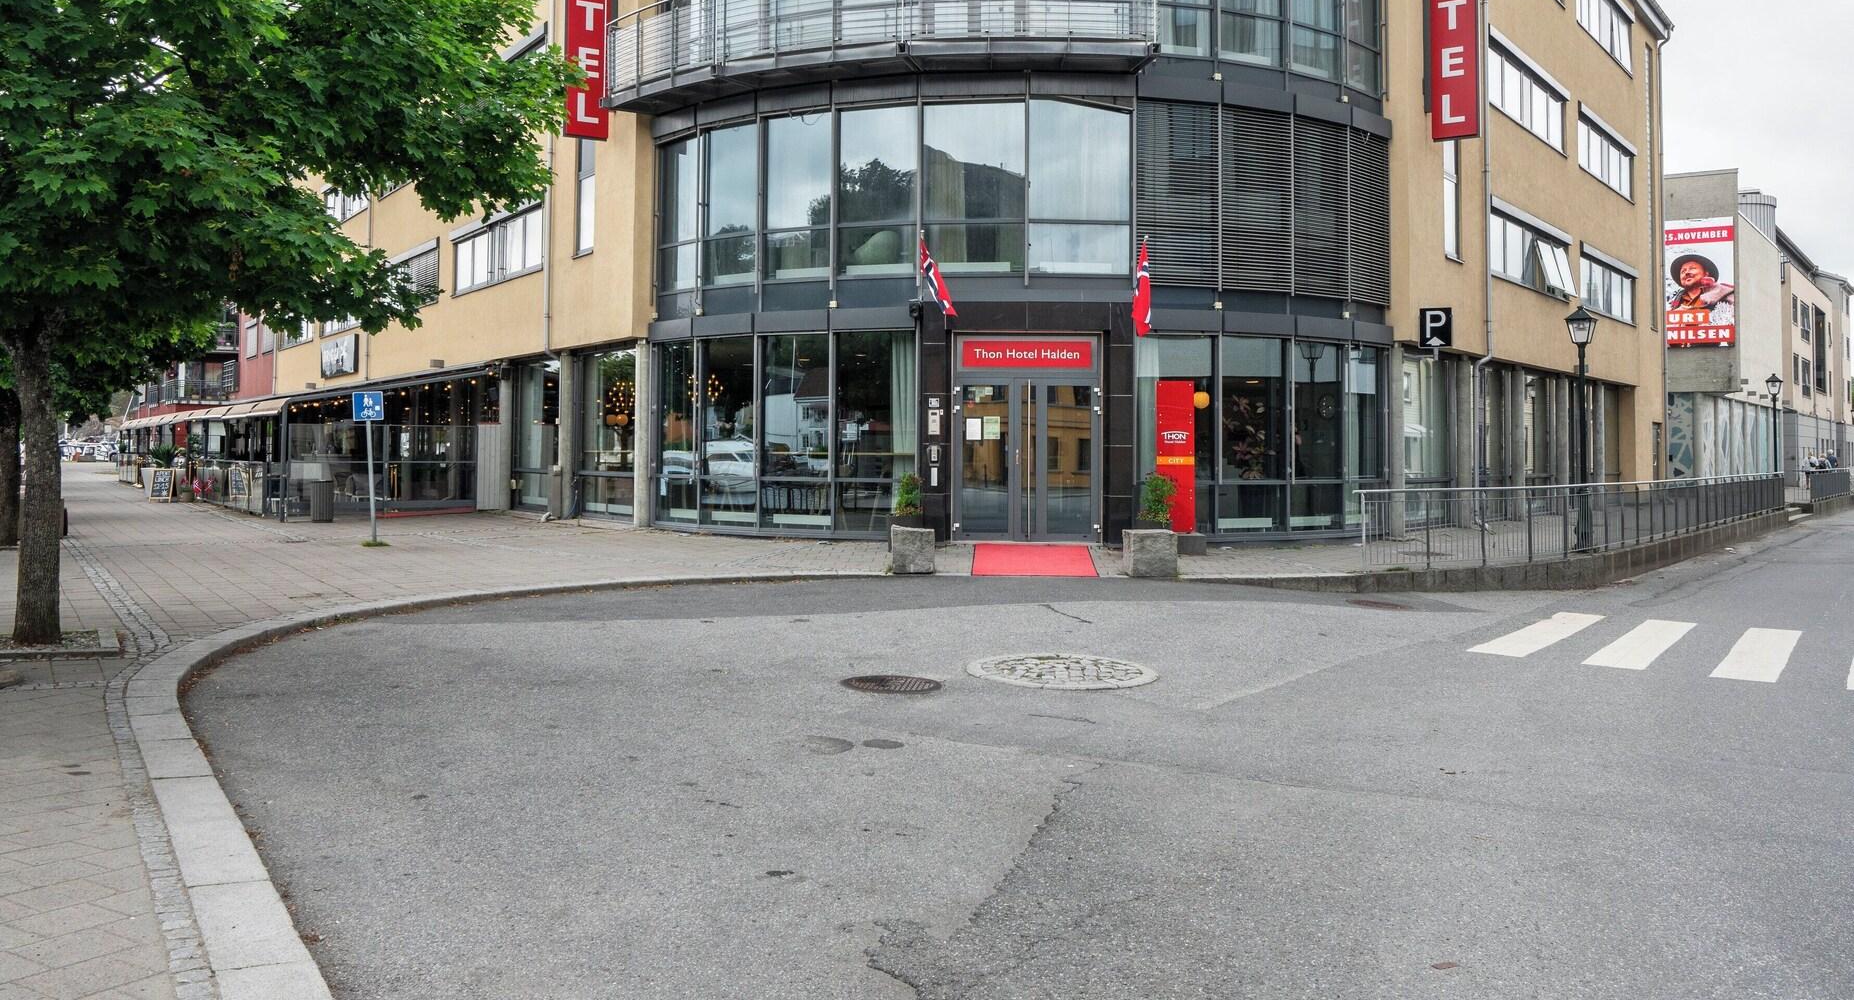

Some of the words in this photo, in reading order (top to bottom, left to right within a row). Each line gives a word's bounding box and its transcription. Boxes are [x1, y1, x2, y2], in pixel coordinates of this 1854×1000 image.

[1668, 312, 1706, 323] URT
[1425, 310, 1446, 338] P
[1667, 328, 1730, 340] NILSEN
[973, 348, 1003, 359] Thon
[1006, 348, 1038, 359] Hotel
[1041, 348, 1080, 360] Halden
[1161, 430, 1190, 440] THON
